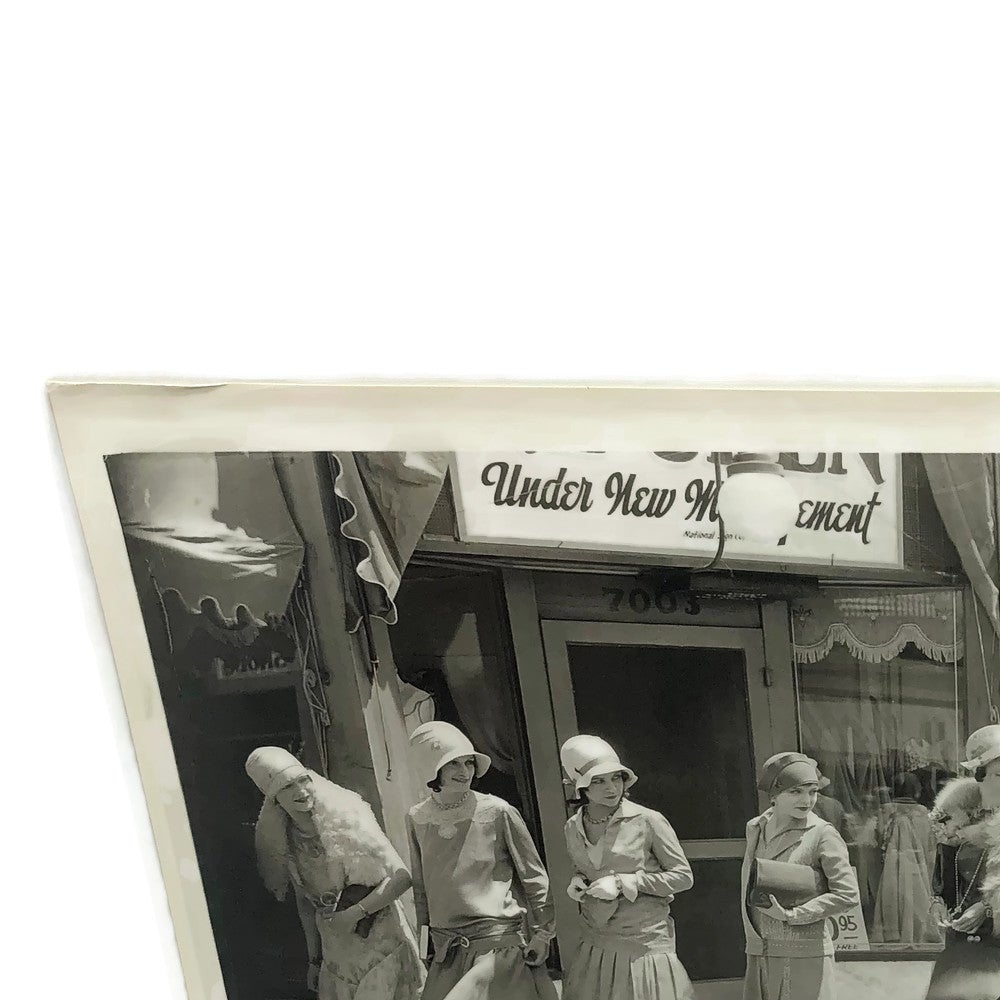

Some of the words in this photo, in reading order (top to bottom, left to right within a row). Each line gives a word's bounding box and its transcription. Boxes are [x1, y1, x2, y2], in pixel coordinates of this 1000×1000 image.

[481, 461, 594, 513] Under
[604, 471, 677, 519] New
[684, 478, 882, 546] Mement
